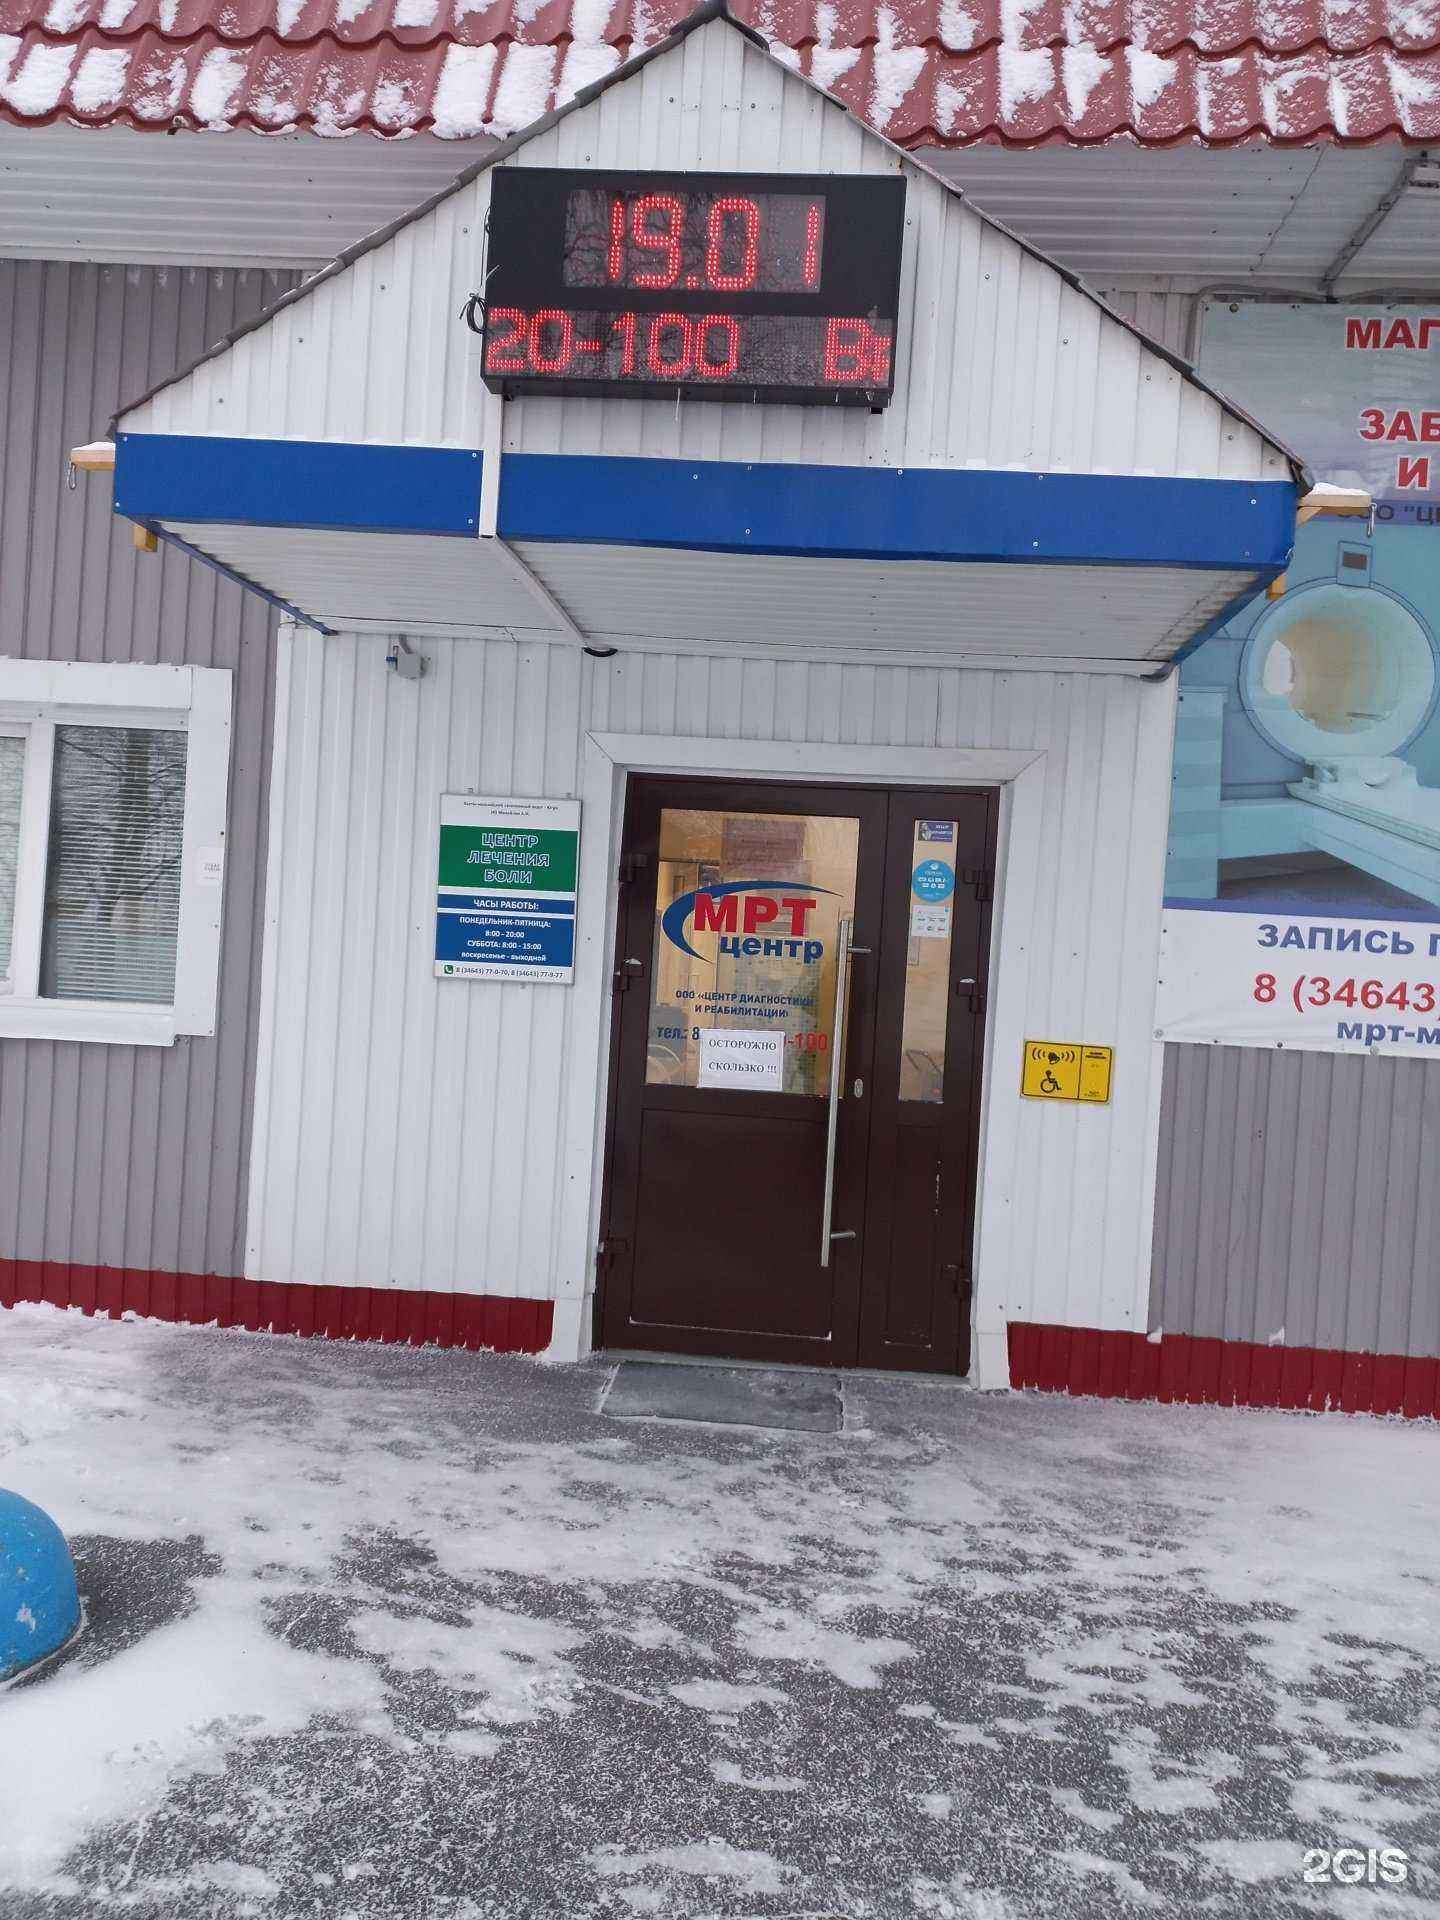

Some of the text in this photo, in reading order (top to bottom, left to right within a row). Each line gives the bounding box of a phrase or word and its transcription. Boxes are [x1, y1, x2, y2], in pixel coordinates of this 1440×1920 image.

[486, 307, 740, 376] 20-100
[1359, 409, 1440, 442] ЗАБ
[1398, 457, 1429, 488] И
[481, 833, 539, 848] ЦЕНТР
[467, 850, 550, 867] ЛЕЧЕНИЯ
[484, 869, 533, 884] БОЛИ
[473, 898, 539, 910] ЧАСЫ РАБОТЫ:
[459, 916, 551, 928] ПОНЕДЕЛЬНИК-ПЯТНИЦА:
[694, 893, 816, 936] МРТ
[467, 940, 501, 948] СУББОТА:
[502, 941, 517, 949] 8:00
[1257, 924, 1415, 955] ЗАПИСЬ
[720, 937, 824, 964] центр
[1254, 973, 1277, 1003] 8
[676, 990, 816, 1006] ООО «ЦЕНТР ДИАГНОСТИКИ
[694, 1004, 702, 1013] И
[692, 1026, 700, 1041] 8
[709, 1039, 777, 1051] ОСТОРОЖНО
[709, 1062, 765, 1073] СКОЛЬЗКО
